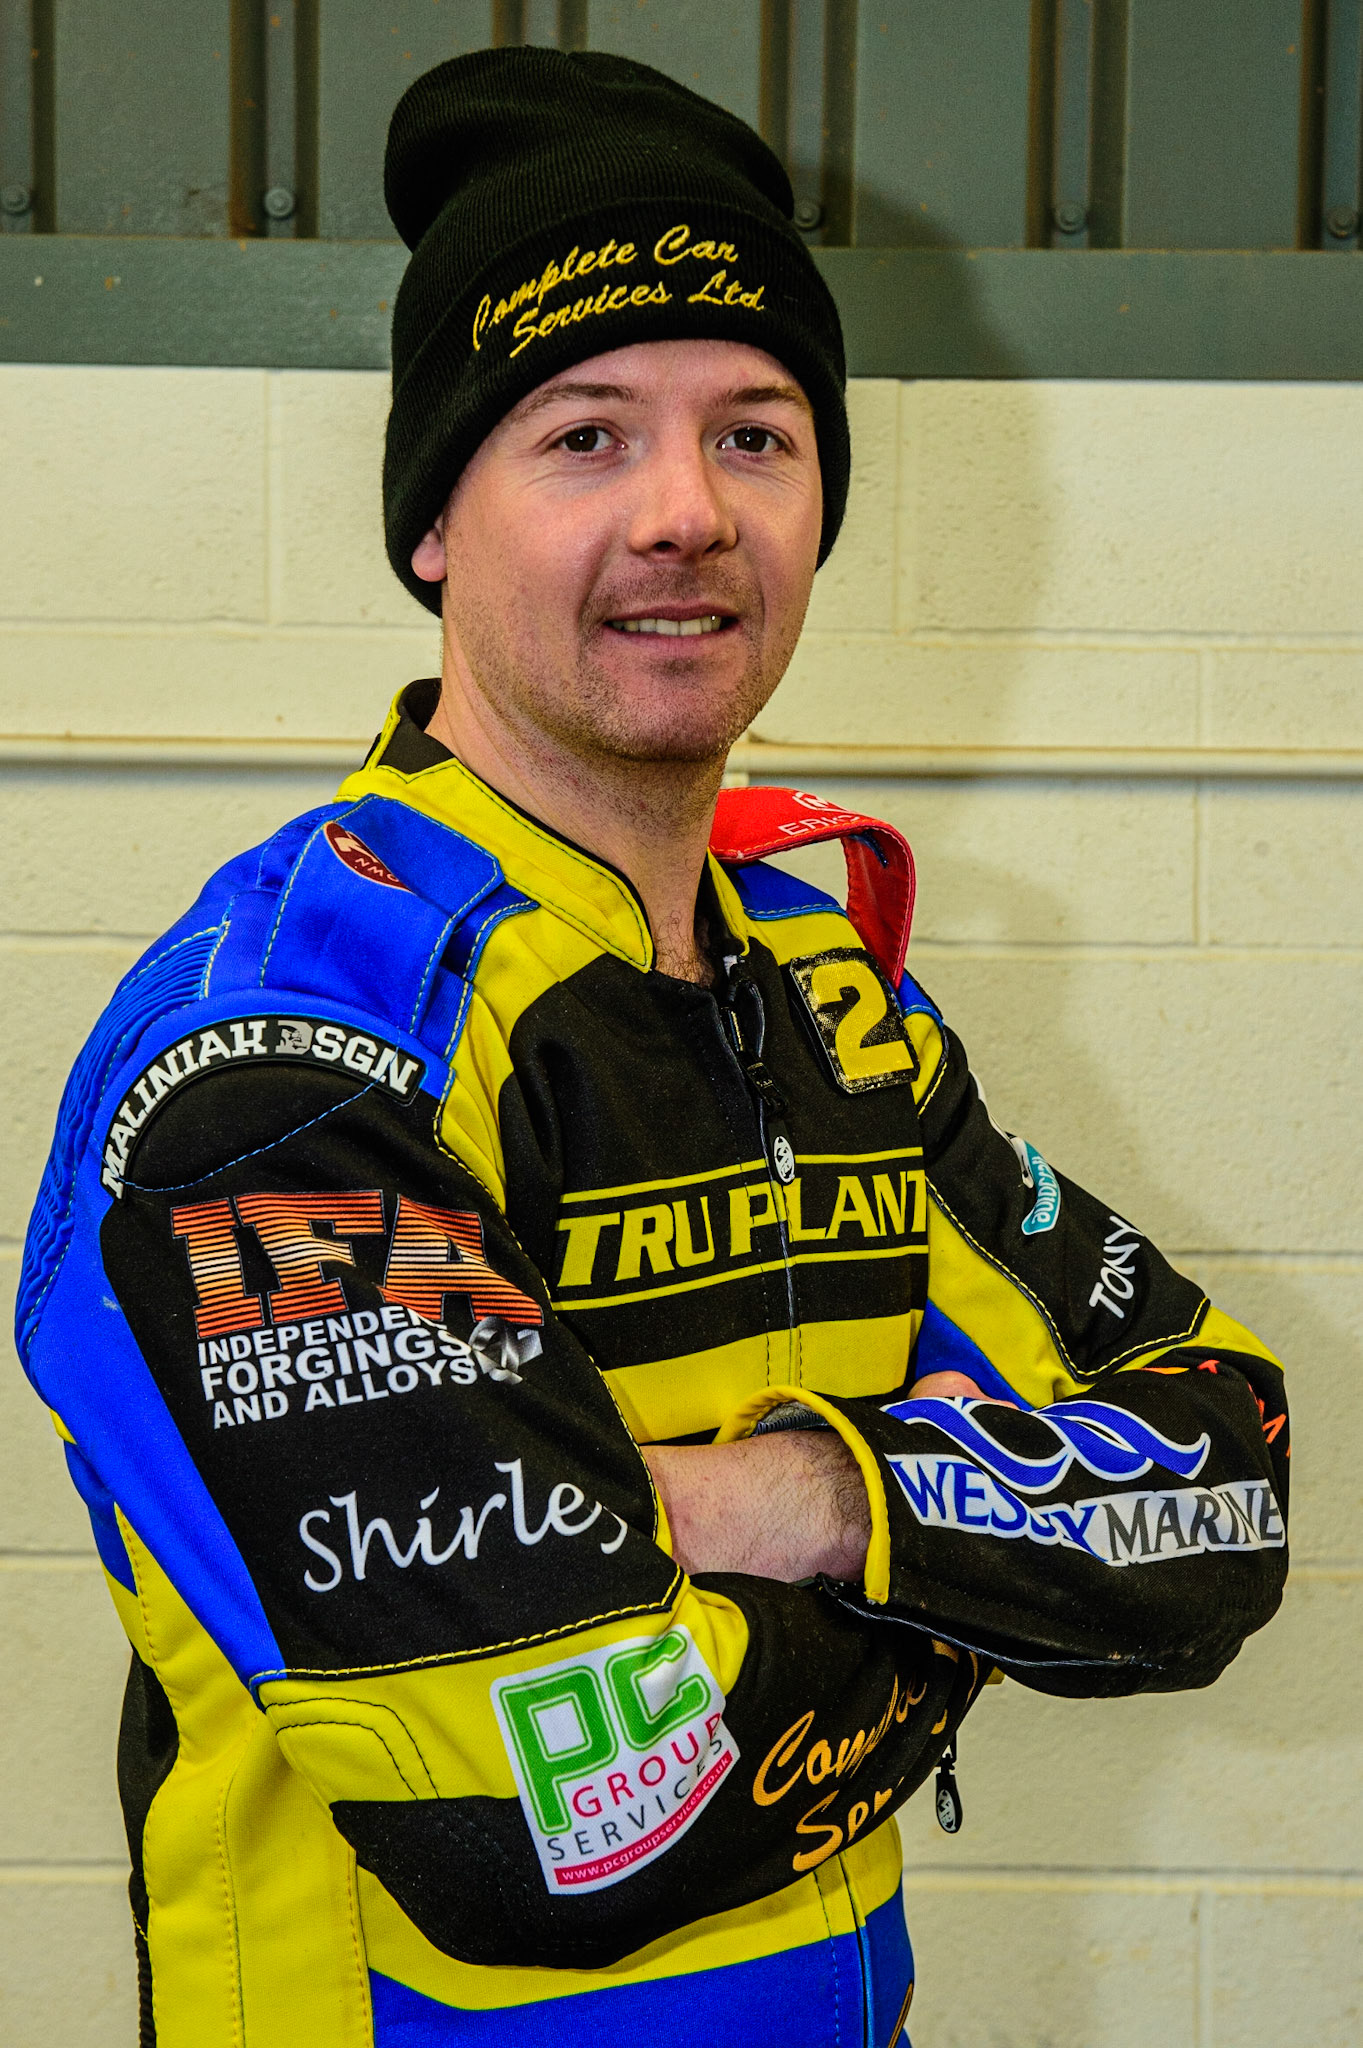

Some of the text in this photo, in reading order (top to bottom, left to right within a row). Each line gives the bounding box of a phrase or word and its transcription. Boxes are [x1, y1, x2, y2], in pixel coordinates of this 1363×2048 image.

[473, 224, 738, 351] Complete Car
[510, 269, 764, 358] Services Ltd
[811, 960, 914, 1080] 2
[171, 1189, 544, 1339] IFA
[1089, 1215, 1145, 1318] TONY
[200, 1327, 472, 1401] FORGINGS
[213, 1357, 478, 1430] AND ALLOYS
[499, 1630, 711, 1836] PC
[572, 1712, 721, 1818] GROUP
[546, 1735, 722, 1861] SERVICES
[562, 1757, 730, 1881] www.pcgroupservices.co.uk
